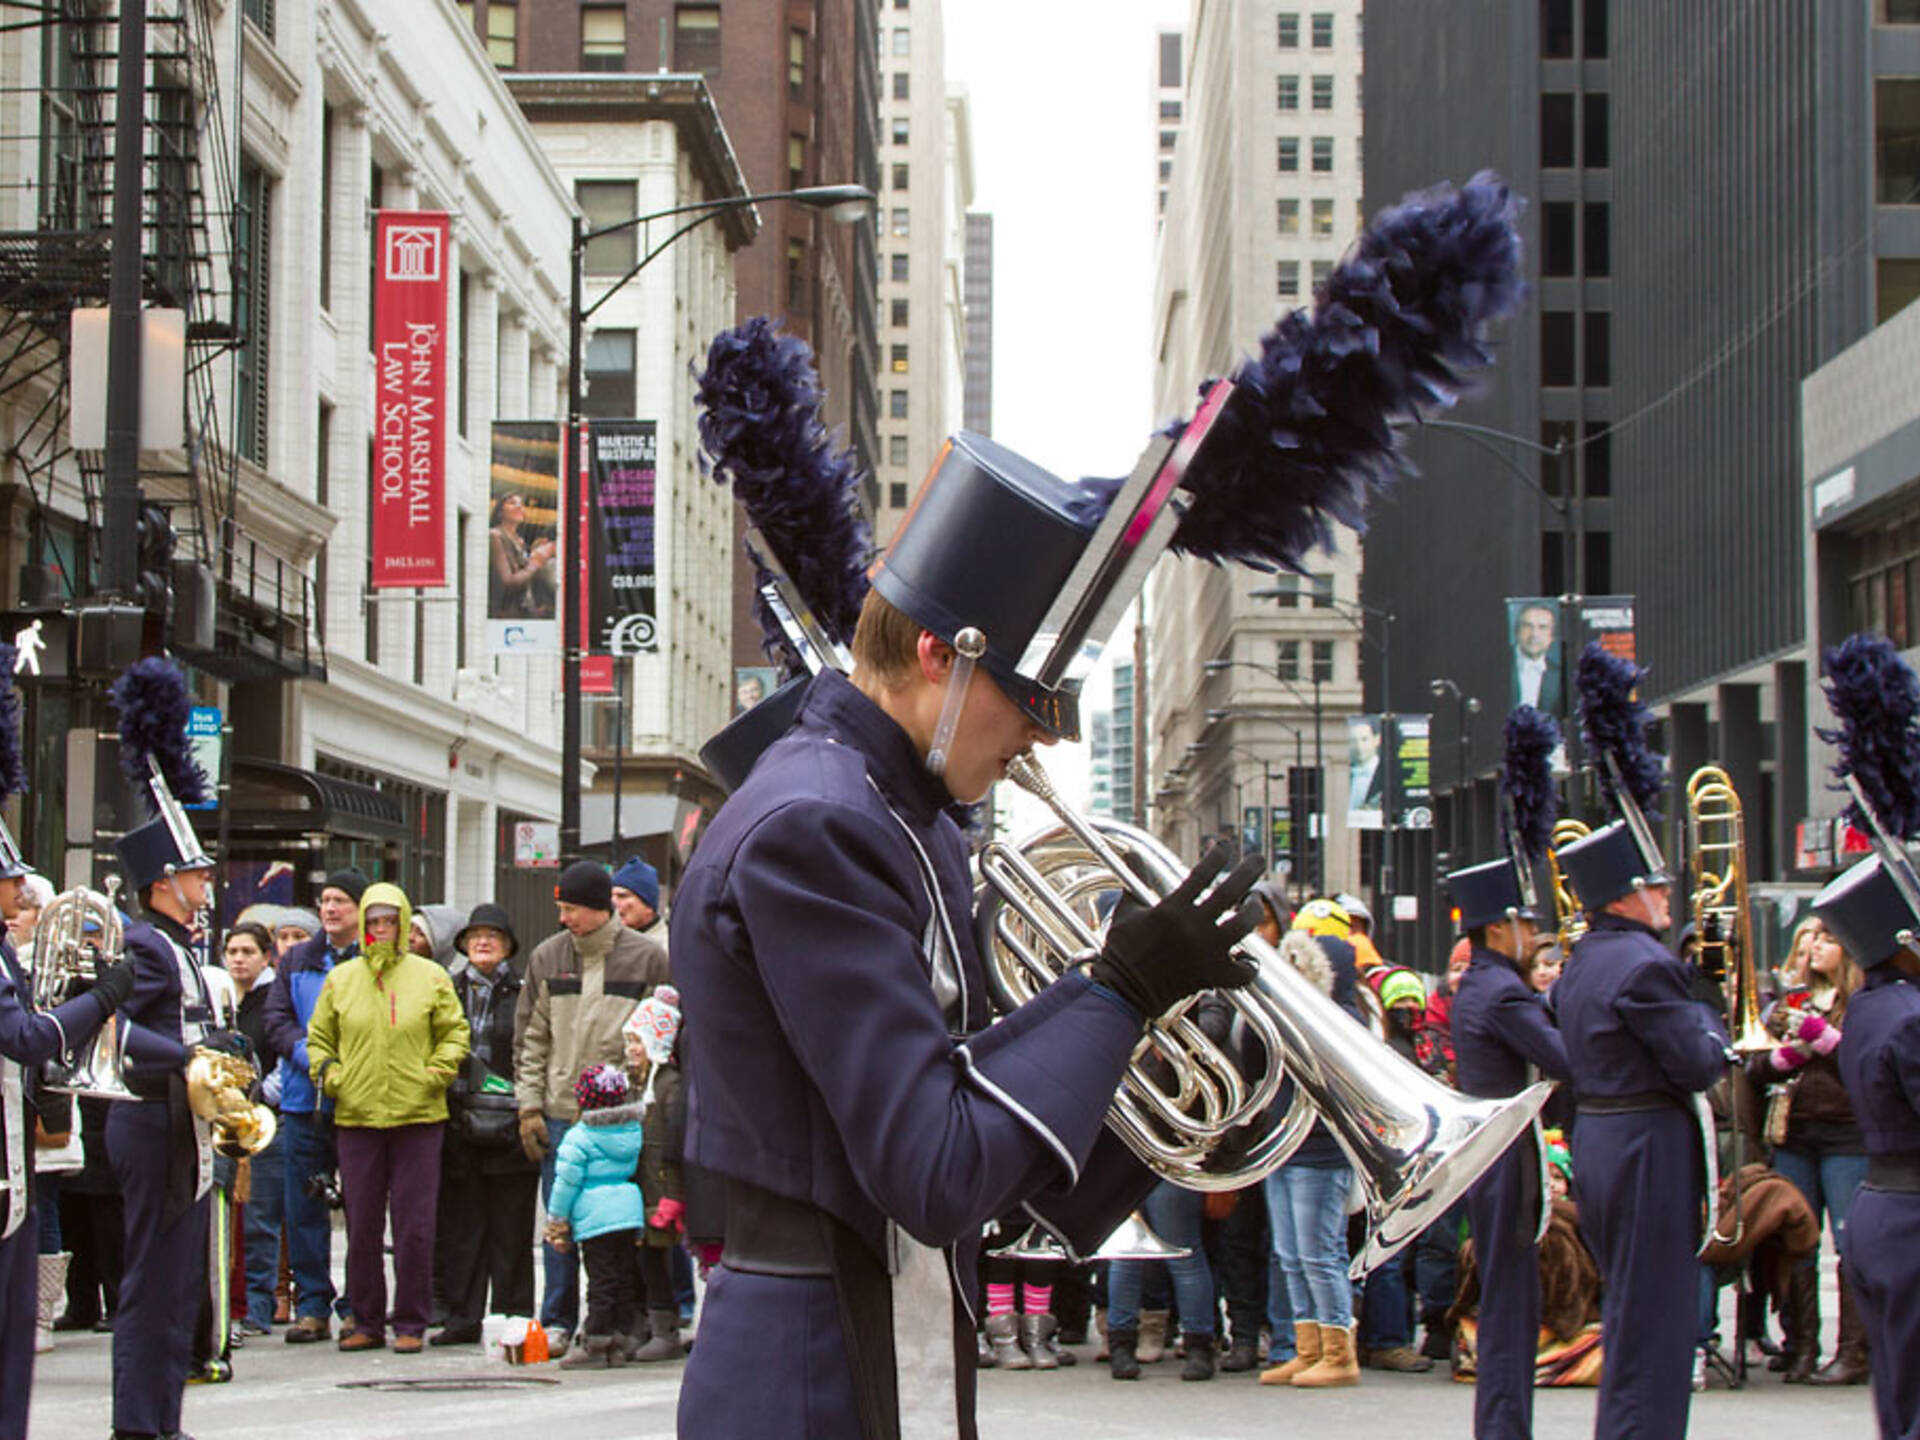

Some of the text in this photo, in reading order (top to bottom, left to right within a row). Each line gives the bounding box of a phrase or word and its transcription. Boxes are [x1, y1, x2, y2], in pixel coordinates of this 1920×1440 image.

[382, 342, 408, 504] LAW SCHOOL
[405, 321, 436, 528] JOHN MARSHALL
[193, 711, 214, 722] bus
[193, 723, 218, 733] stop
